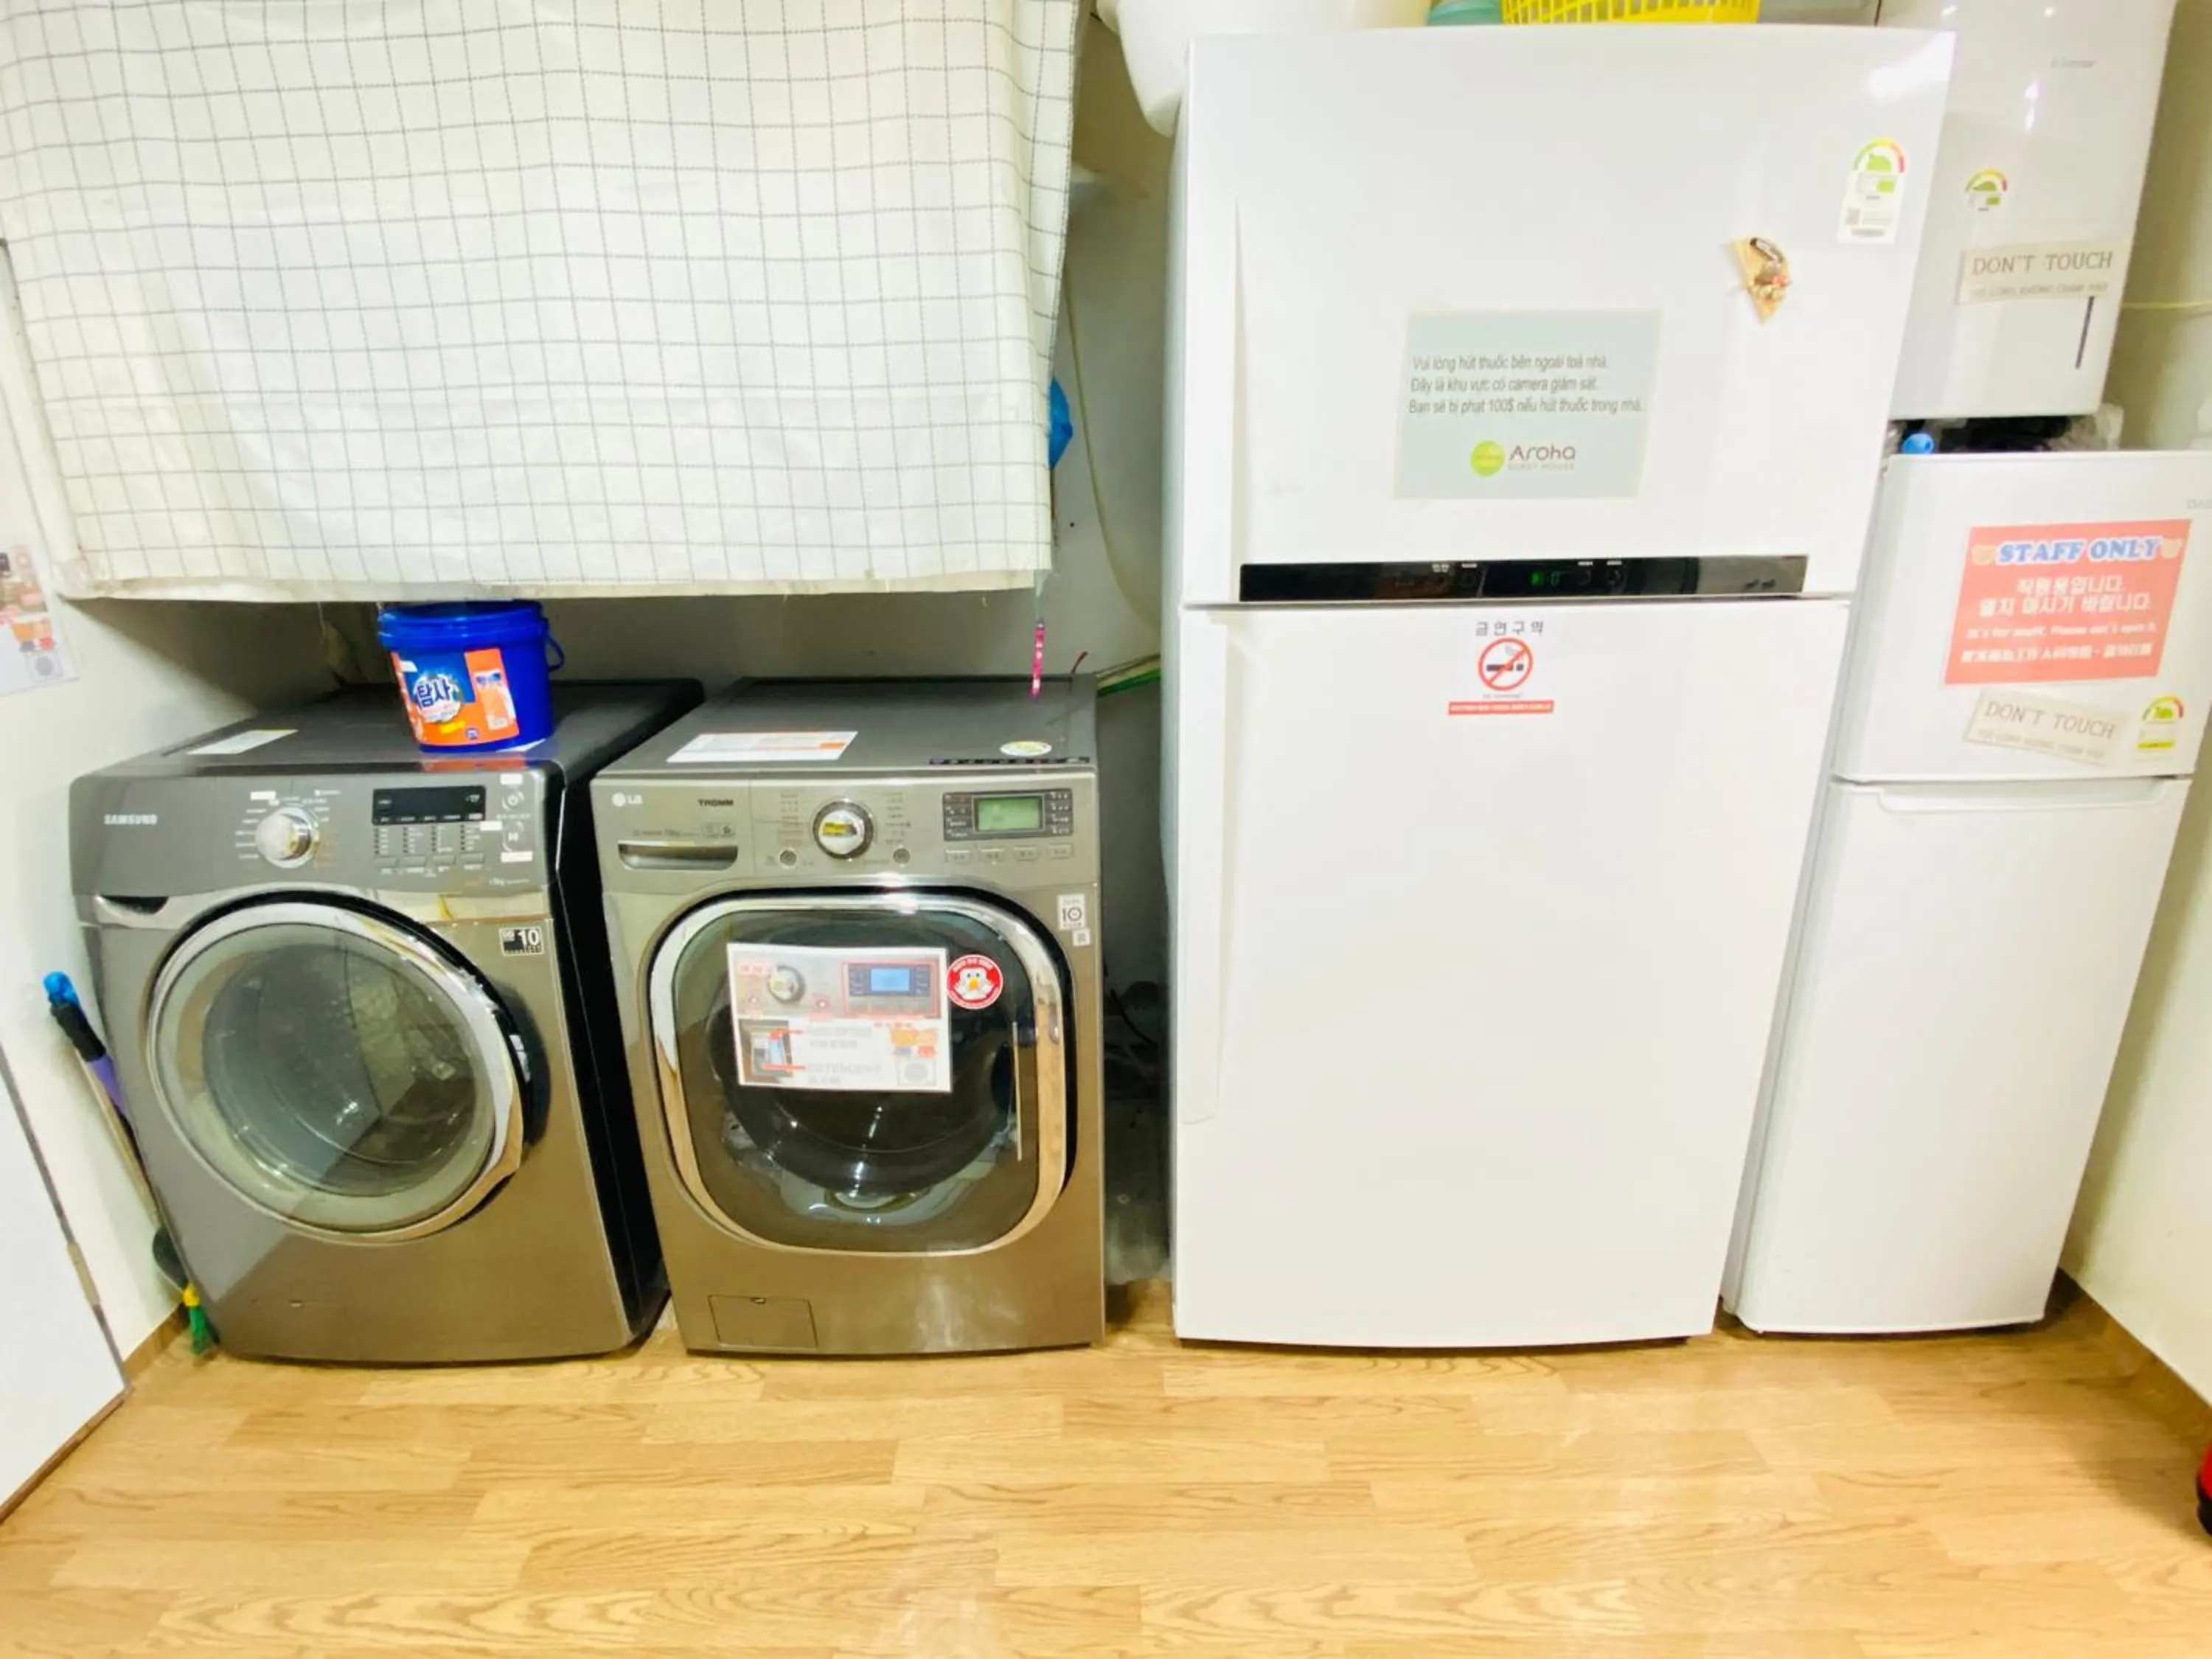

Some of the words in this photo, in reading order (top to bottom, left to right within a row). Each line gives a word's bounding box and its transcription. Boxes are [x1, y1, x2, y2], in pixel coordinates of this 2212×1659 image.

[2045, 251, 2112, 271] TOUCH
[1509, 378, 1548, 391] camera
[1509, 443, 1576, 462] Aroha
[1997, 540, 2085, 564] STAFF
[2090, 538, 2162, 561] ONLY
[417, 678, 451, 710] 탐사
[2053, 712, 2118, 740] TOUCH
[518, 929, 539, 947] 10
